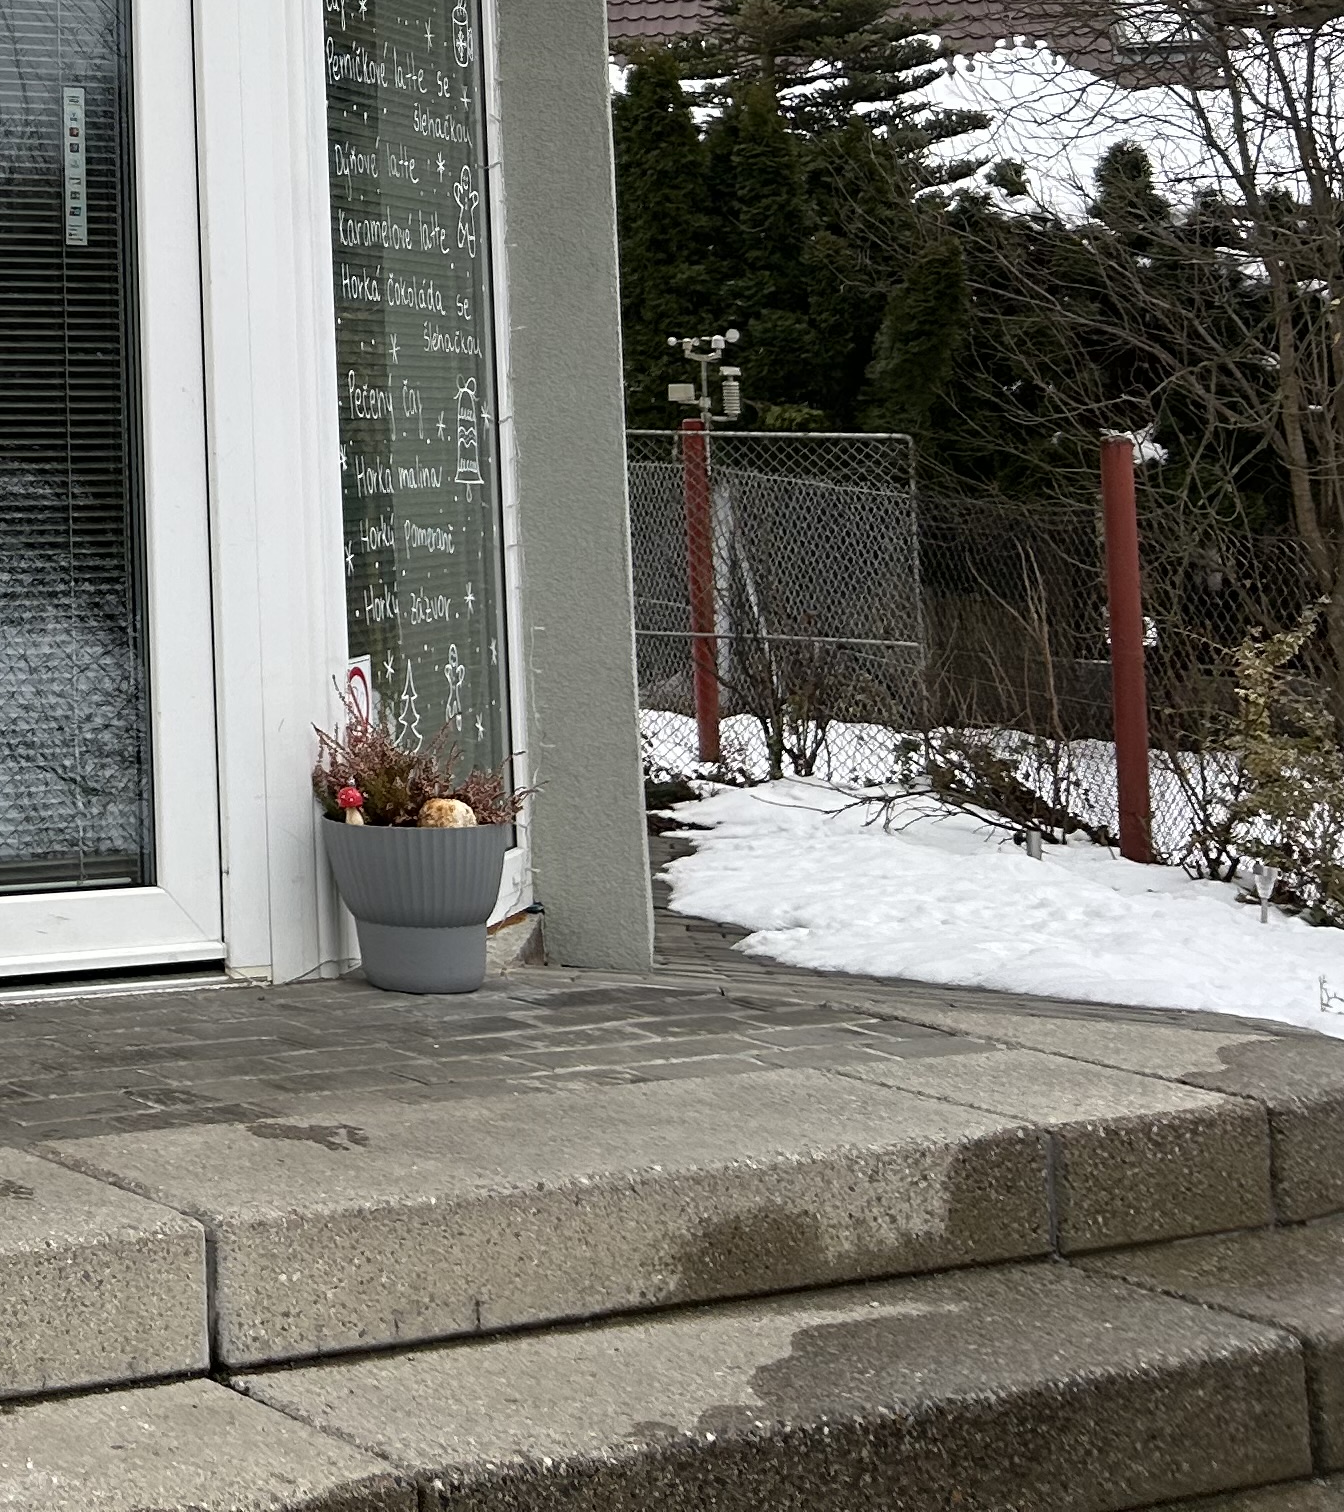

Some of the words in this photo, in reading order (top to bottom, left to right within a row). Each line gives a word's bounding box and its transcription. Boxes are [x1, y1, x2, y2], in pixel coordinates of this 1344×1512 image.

[326, 36, 388, 88] Perníčkové
[393, 46, 428, 94] latte
[436, 70, 451, 98] se
[413, 102, 473, 149] šlehačkou
[334, 135, 380, 202] Dýňové
[386, 142, 420, 184] latte
[418, 209, 450, 254] latte
[341, 262, 381, 302] Horká
[456, 294, 472, 321] se
[348, 369, 396, 441] Pečený
[355, 453, 394, 498] Horká
[398, 454, 443, 489] malina
[359, 512, 397, 570] Horký
[363, 581, 403, 645] Horký
